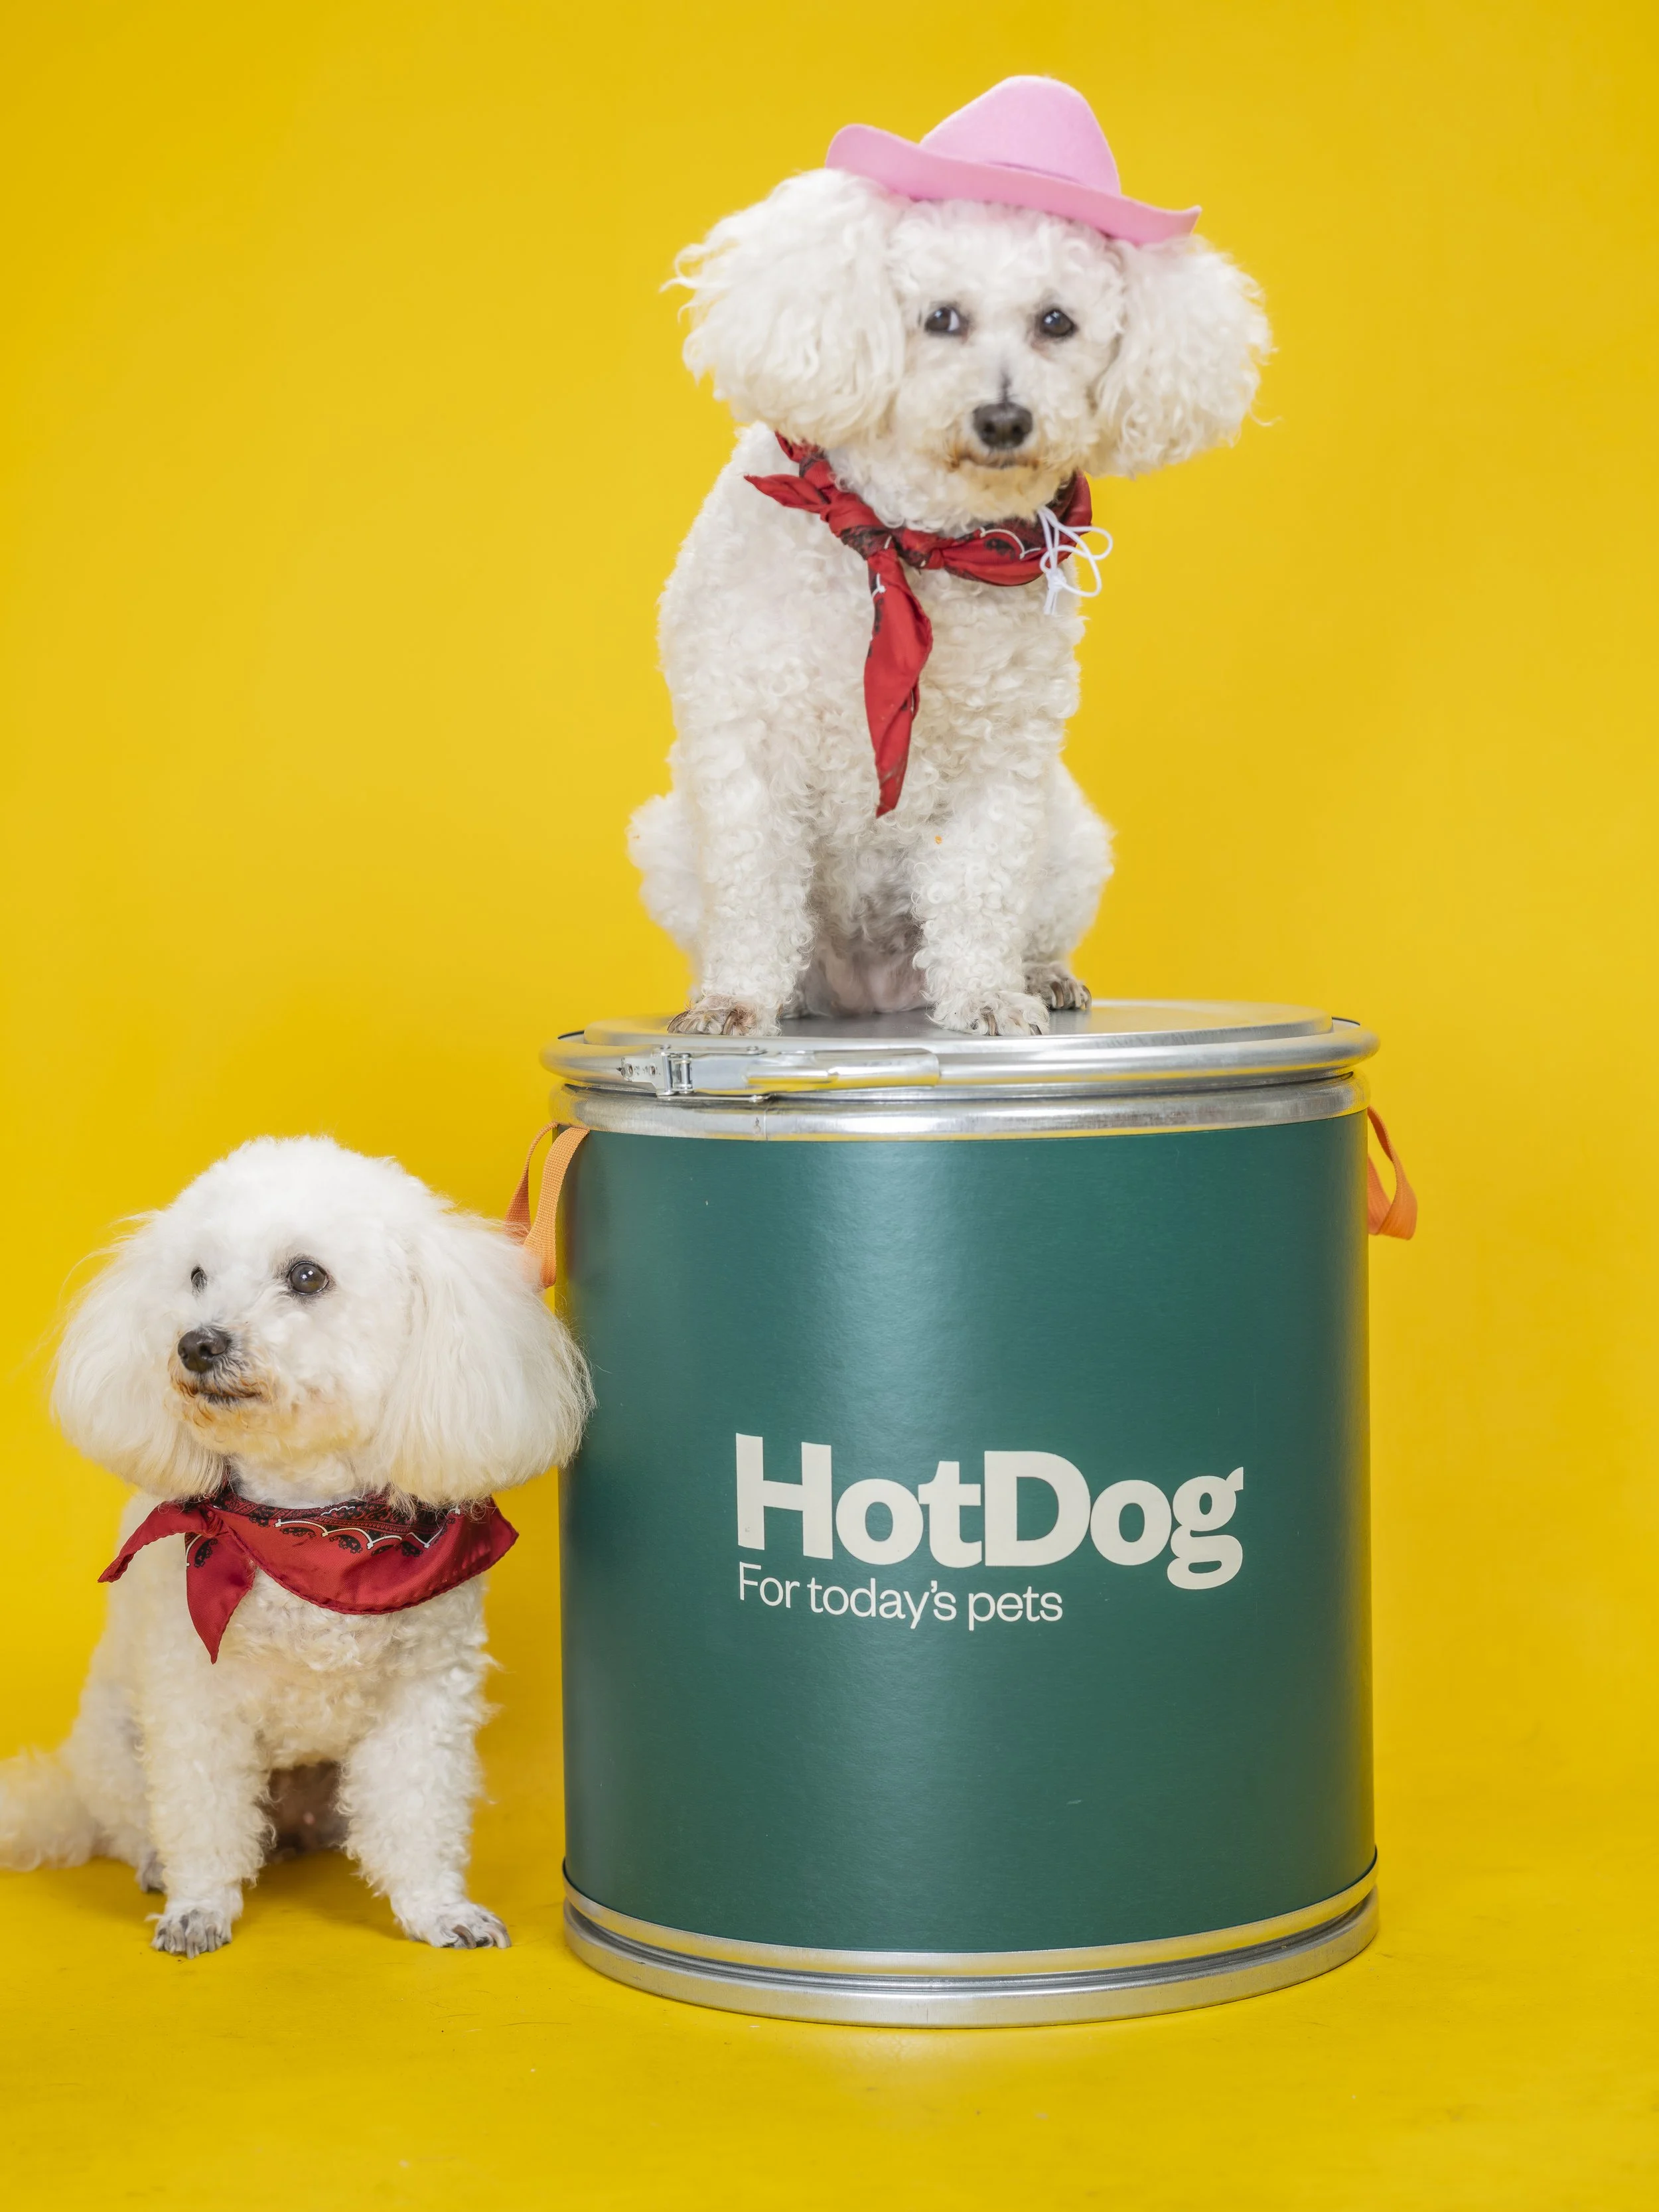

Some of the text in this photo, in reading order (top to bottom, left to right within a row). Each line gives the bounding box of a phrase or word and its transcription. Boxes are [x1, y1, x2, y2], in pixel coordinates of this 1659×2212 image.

[736, 1433, 1244, 1590] HotDog
[739, 1561, 1063, 1631] For today's pets
